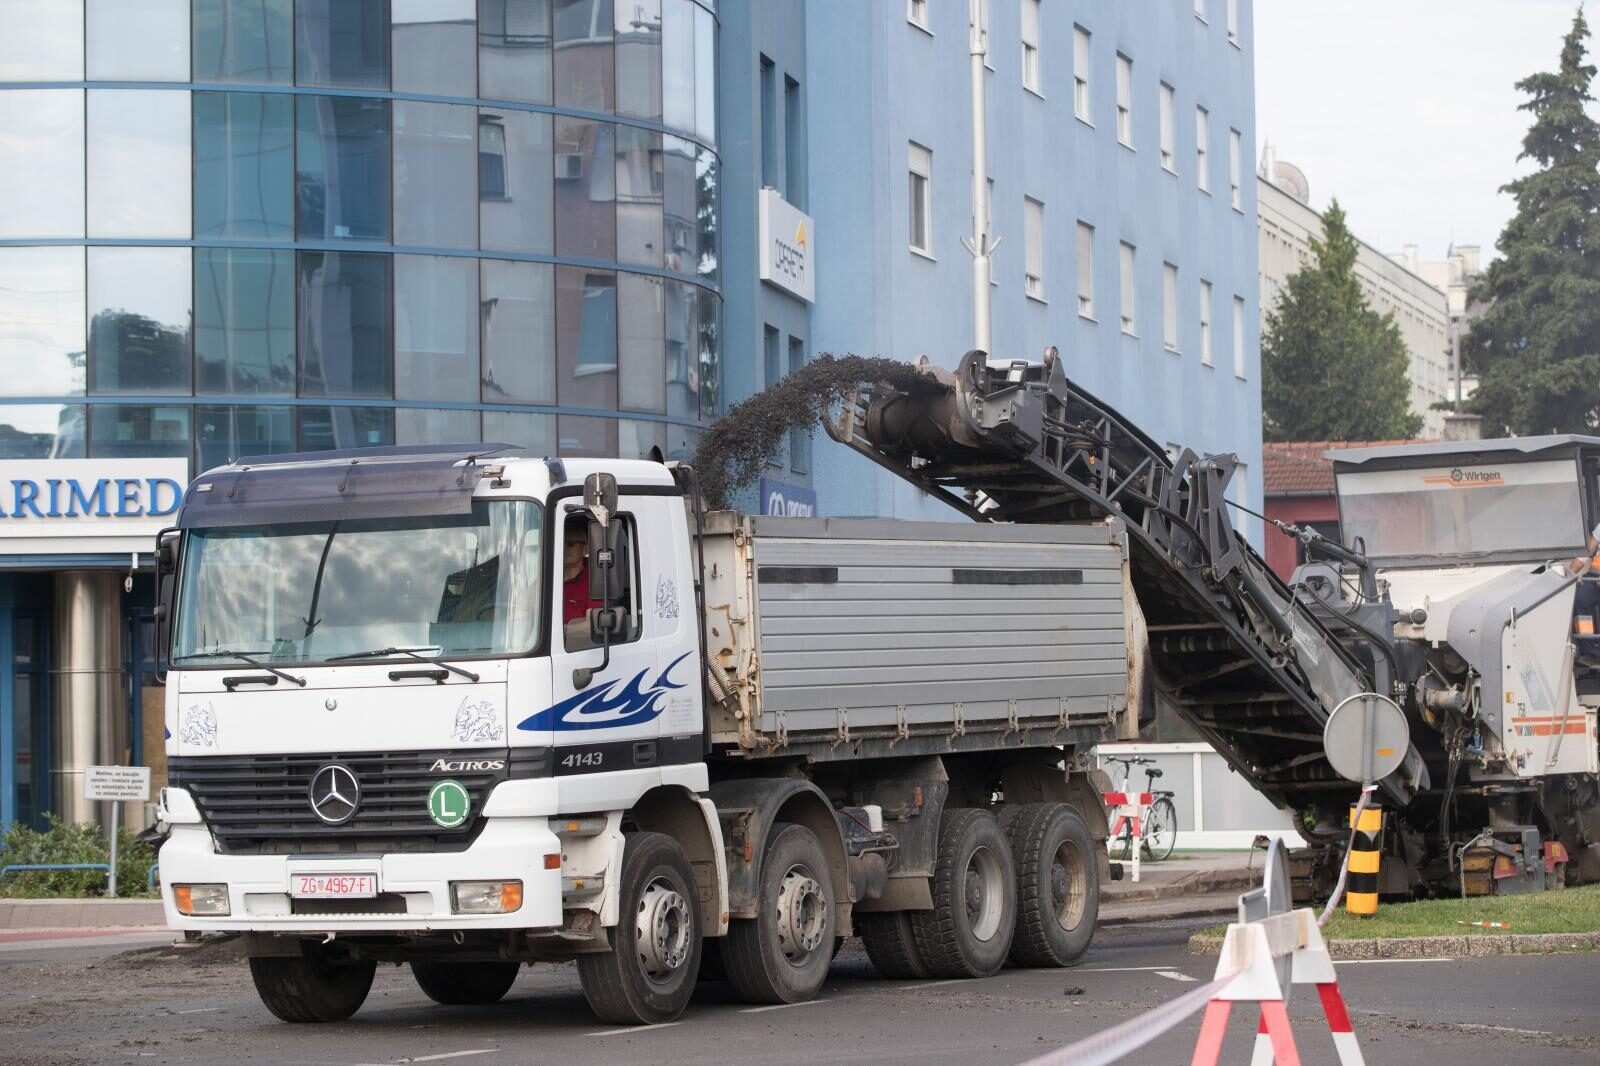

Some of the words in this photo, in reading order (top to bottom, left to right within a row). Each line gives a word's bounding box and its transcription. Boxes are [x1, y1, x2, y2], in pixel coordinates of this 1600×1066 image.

[1465, 472, 1501, 482] Wirtgen
[0, 478, 183, 518] RIMED
[429, 759, 505, 772] ACTROS
[561, 752, 603, 767] 4143
[440, 791, 457, 817] L
[301, 878, 316, 893] ZG
